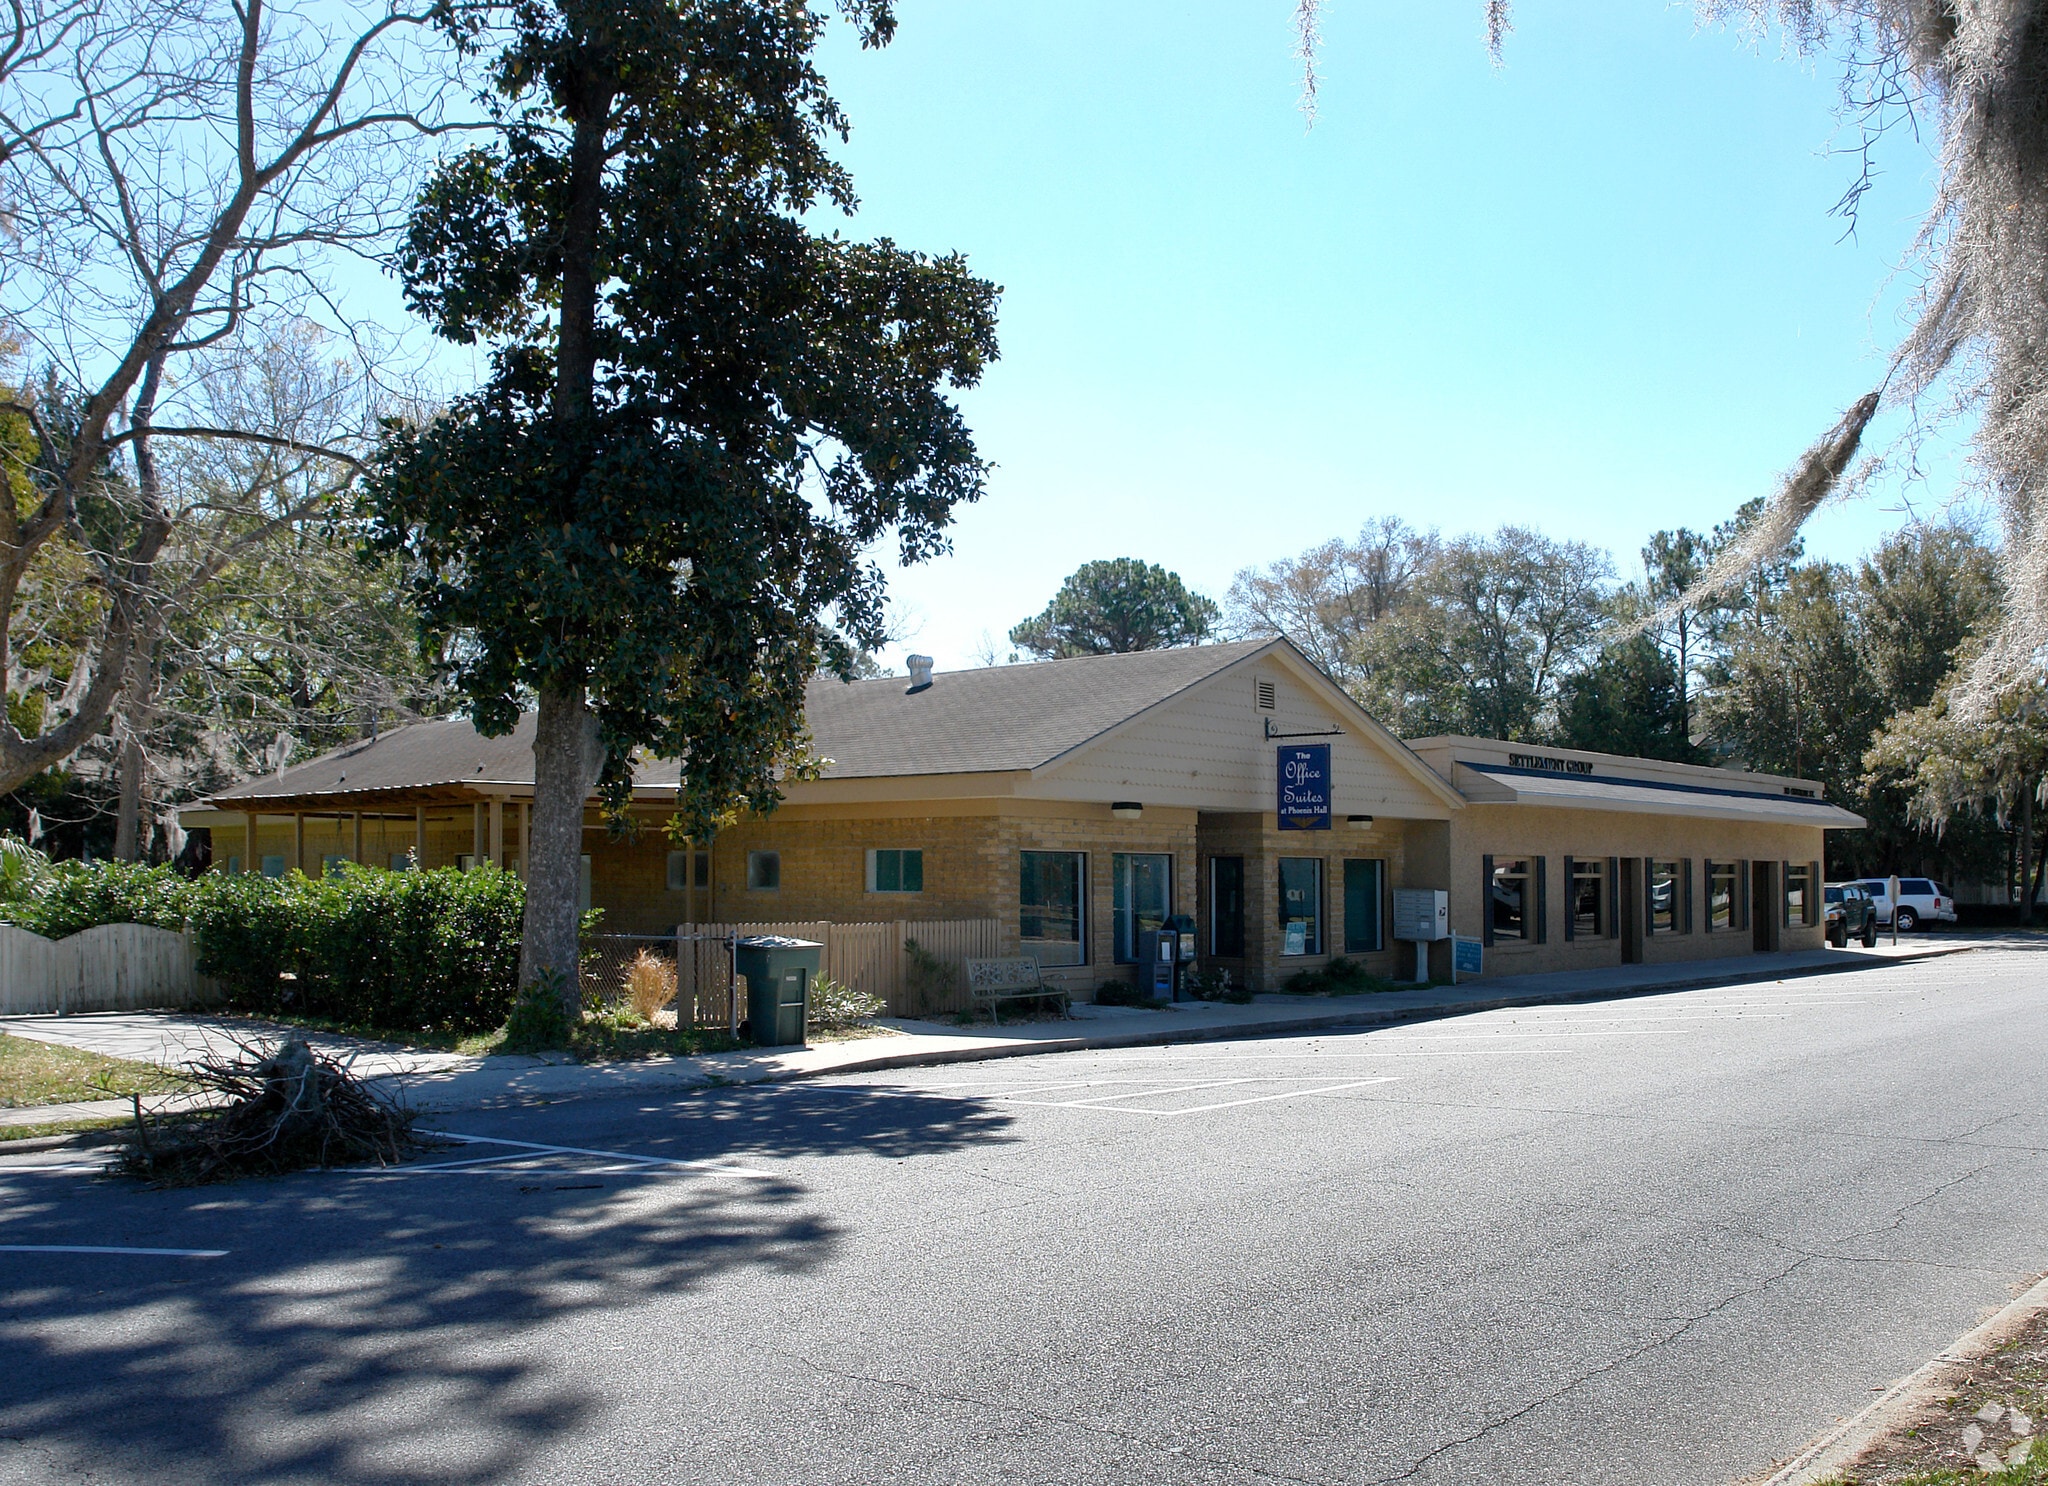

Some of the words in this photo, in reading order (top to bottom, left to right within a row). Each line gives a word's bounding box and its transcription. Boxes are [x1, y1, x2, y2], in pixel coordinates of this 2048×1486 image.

[1285, 761, 1321, 786] Office
[1566, 760, 1593, 774] GROUP
[1284, 785, 1324, 803] Suites
[1288, 806, 1312, 814] Phoenix
[1313, 805, 1328, 814] Hall
